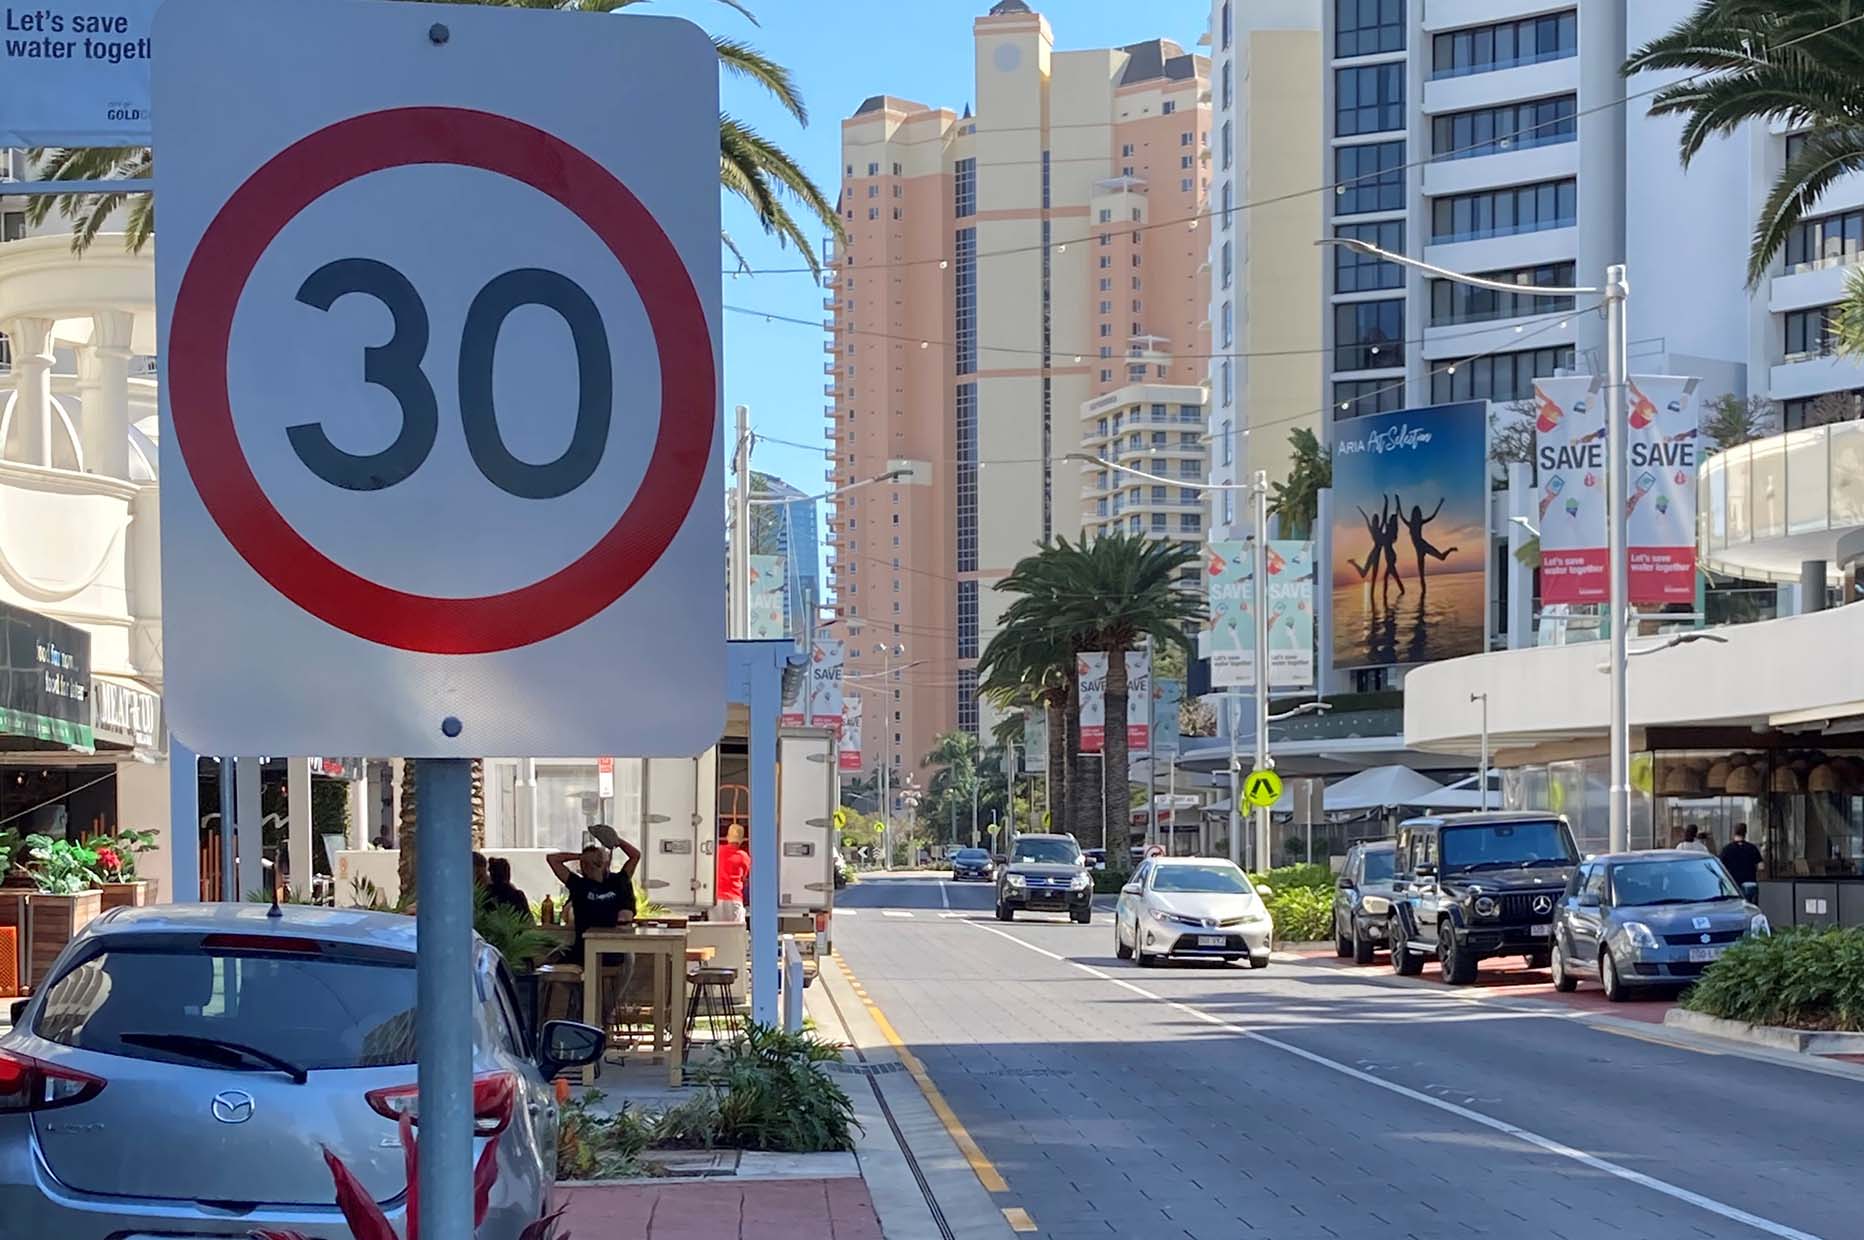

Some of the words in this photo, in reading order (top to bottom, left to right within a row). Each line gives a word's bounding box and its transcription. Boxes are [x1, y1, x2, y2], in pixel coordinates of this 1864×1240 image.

[6, 8, 64, 32] Let's
[72, 15, 128, 33] save
[6, 37, 77, 58] water
[285, 257, 613, 500] 30
[1337, 440, 1366, 456] ARIA
[1631, 442, 1694, 467] SAVE
[1540, 444, 1602, 470] SAVE
[1544, 557, 1563, 566] Let's
[1631, 554, 1650, 562] Let's
[1569, 564, 1604, 575] together
[1655, 563, 1690, 573] together
[1211, 583, 1252, 599] SAVE
[1270, 583, 1312, 599] SAVE
[751, 592, 783, 609] AVE
[814, 668, 841, 681] SAVE
[1127, 680, 1147, 691] AVE
